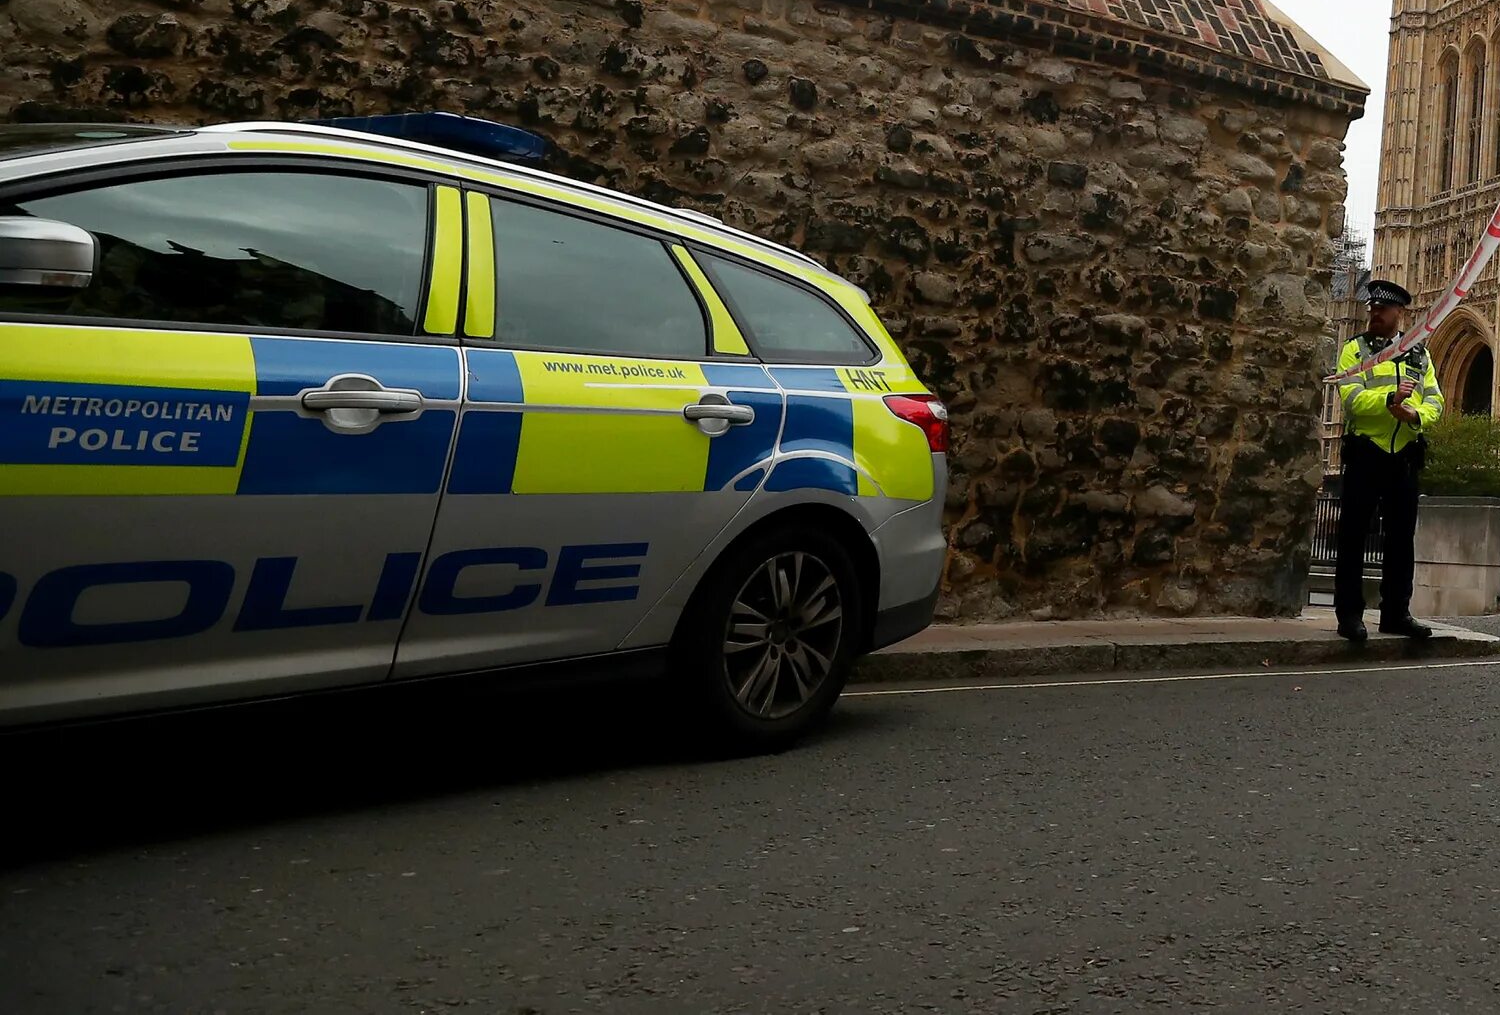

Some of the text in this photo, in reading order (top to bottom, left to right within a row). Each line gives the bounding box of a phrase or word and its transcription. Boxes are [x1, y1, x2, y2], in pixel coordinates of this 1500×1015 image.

[542, 360, 686, 379] www.met.police.uk
[849, 369, 889, 392] HNT
[21, 395, 233, 422] METROPOLITAN
[48, 427, 200, 453] POLICE
